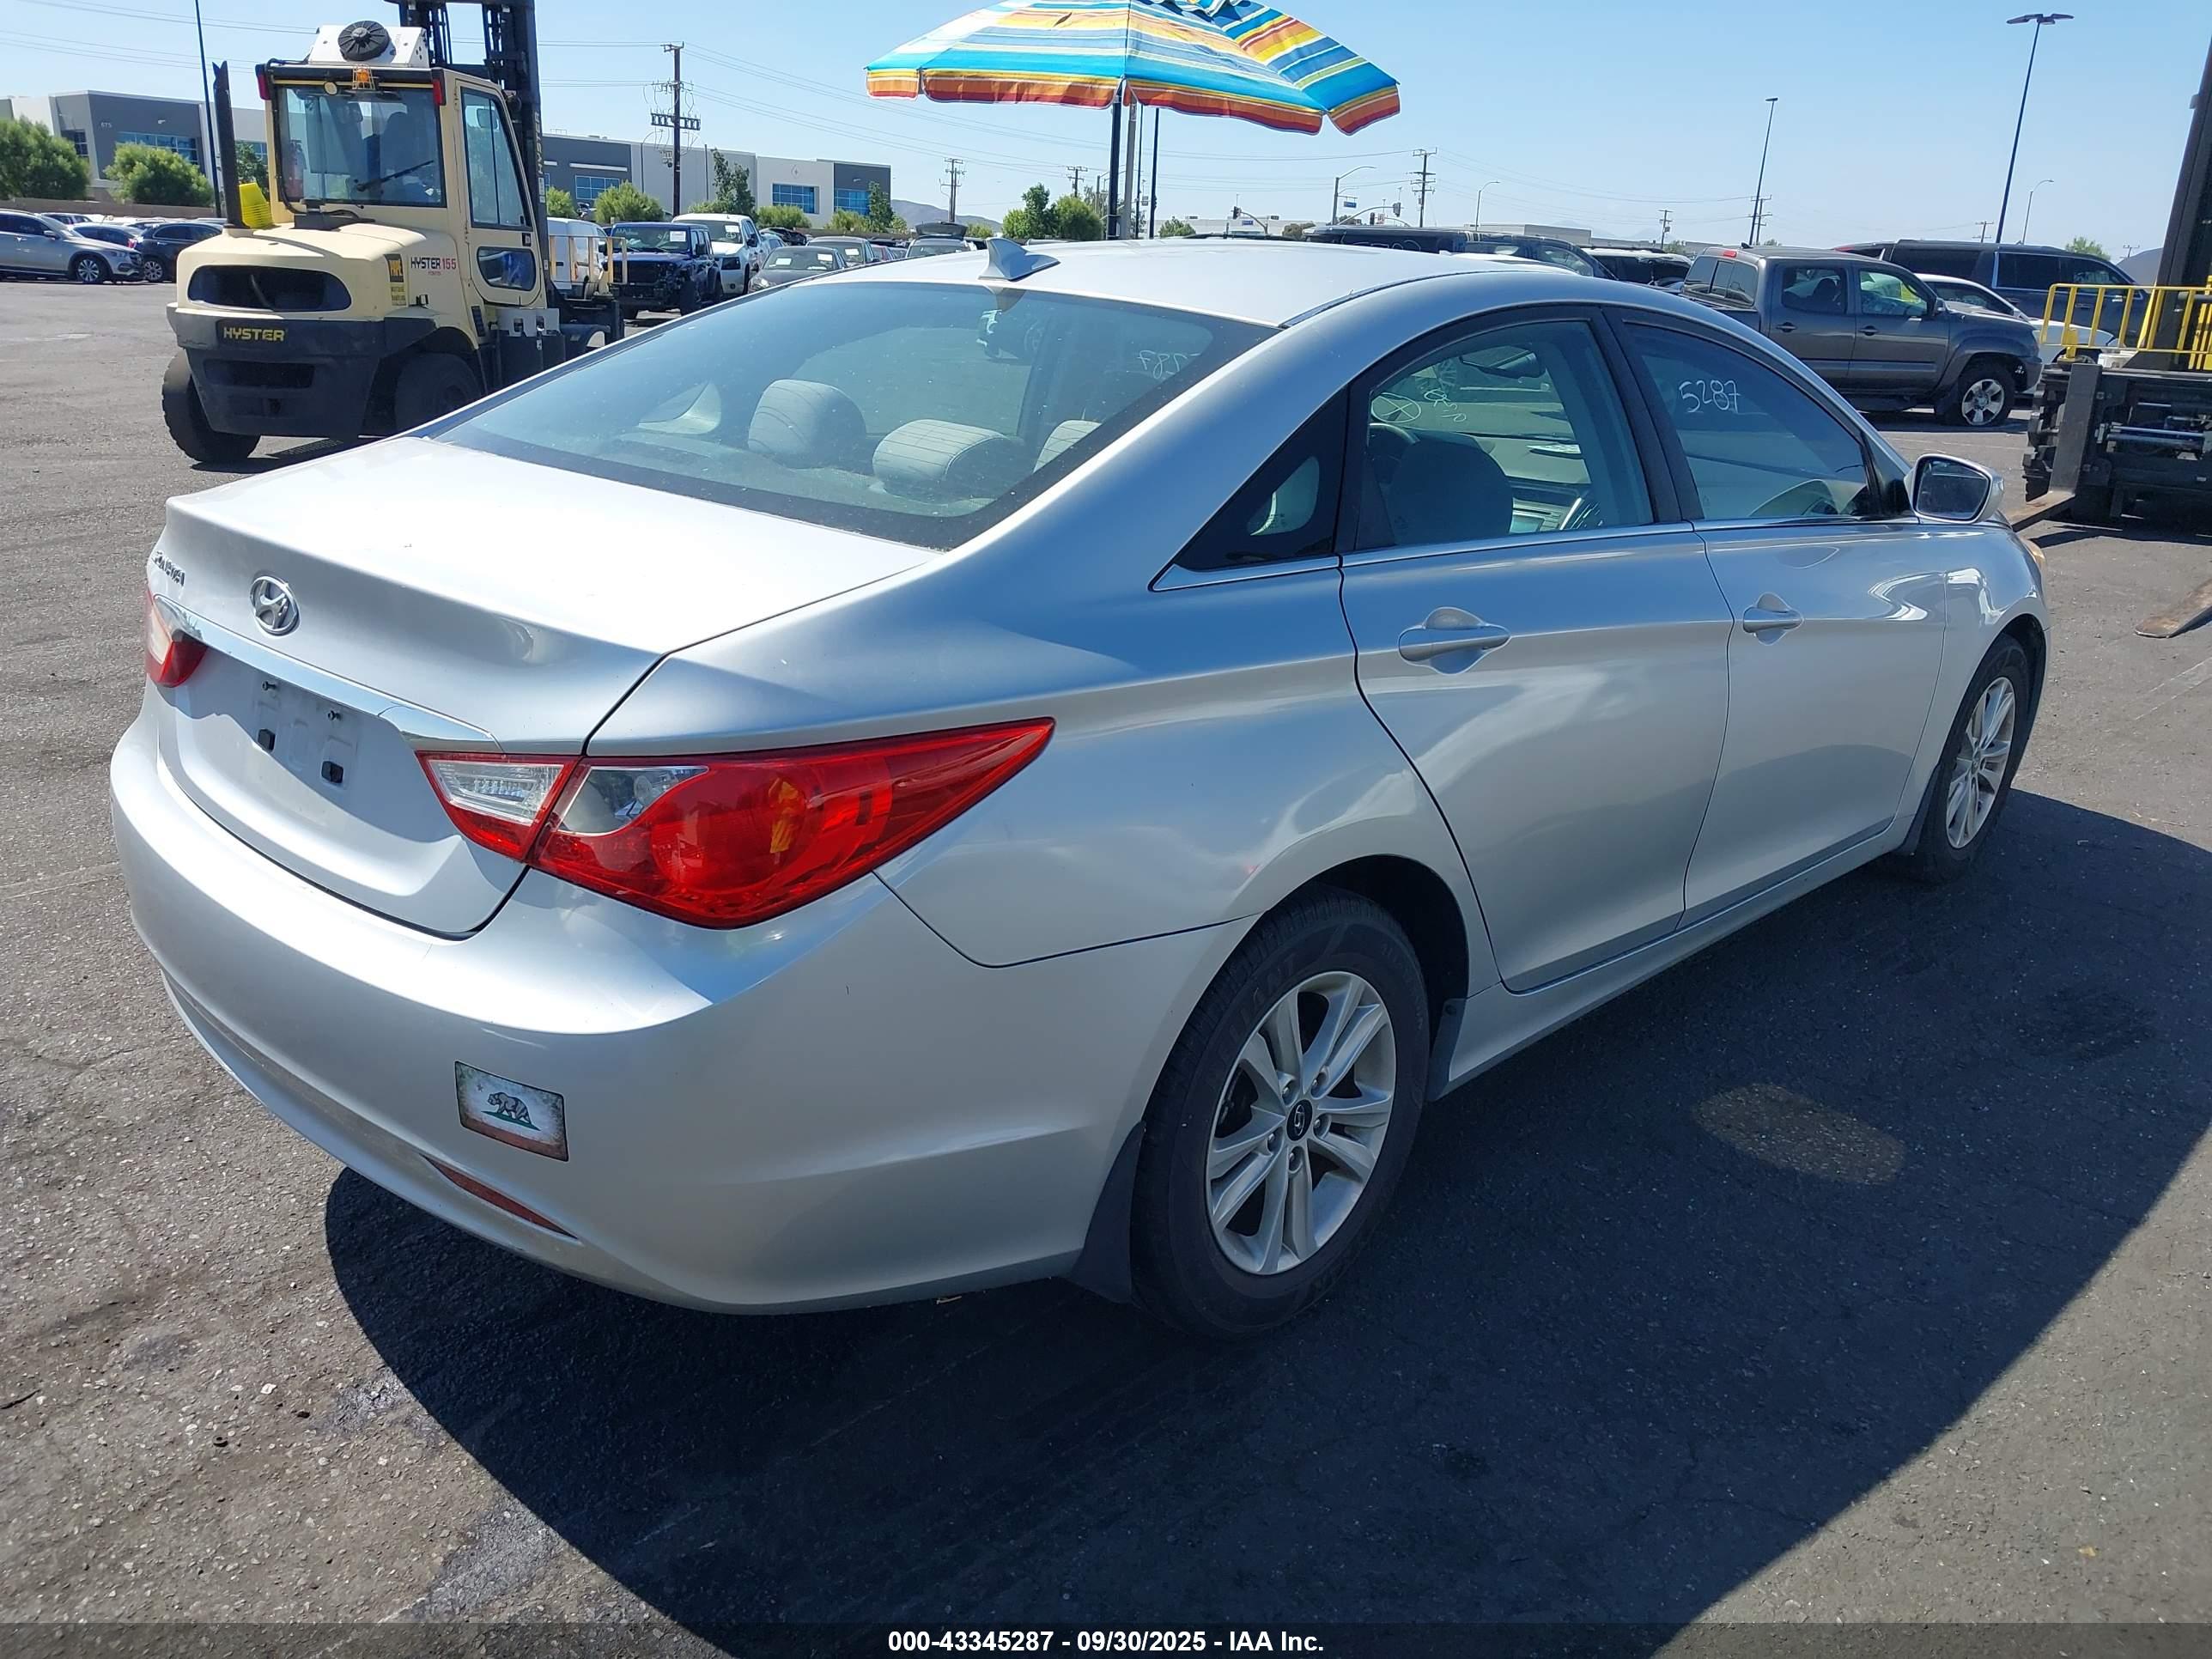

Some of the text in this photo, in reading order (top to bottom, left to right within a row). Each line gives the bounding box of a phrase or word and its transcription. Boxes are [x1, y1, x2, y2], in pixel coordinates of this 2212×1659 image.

[410, 257, 441, 270] HYSTER
[442, 258, 456, 270] 155
[223, 326, 285, 342] HYSTER
[1679, 380, 1741, 413] 5287
